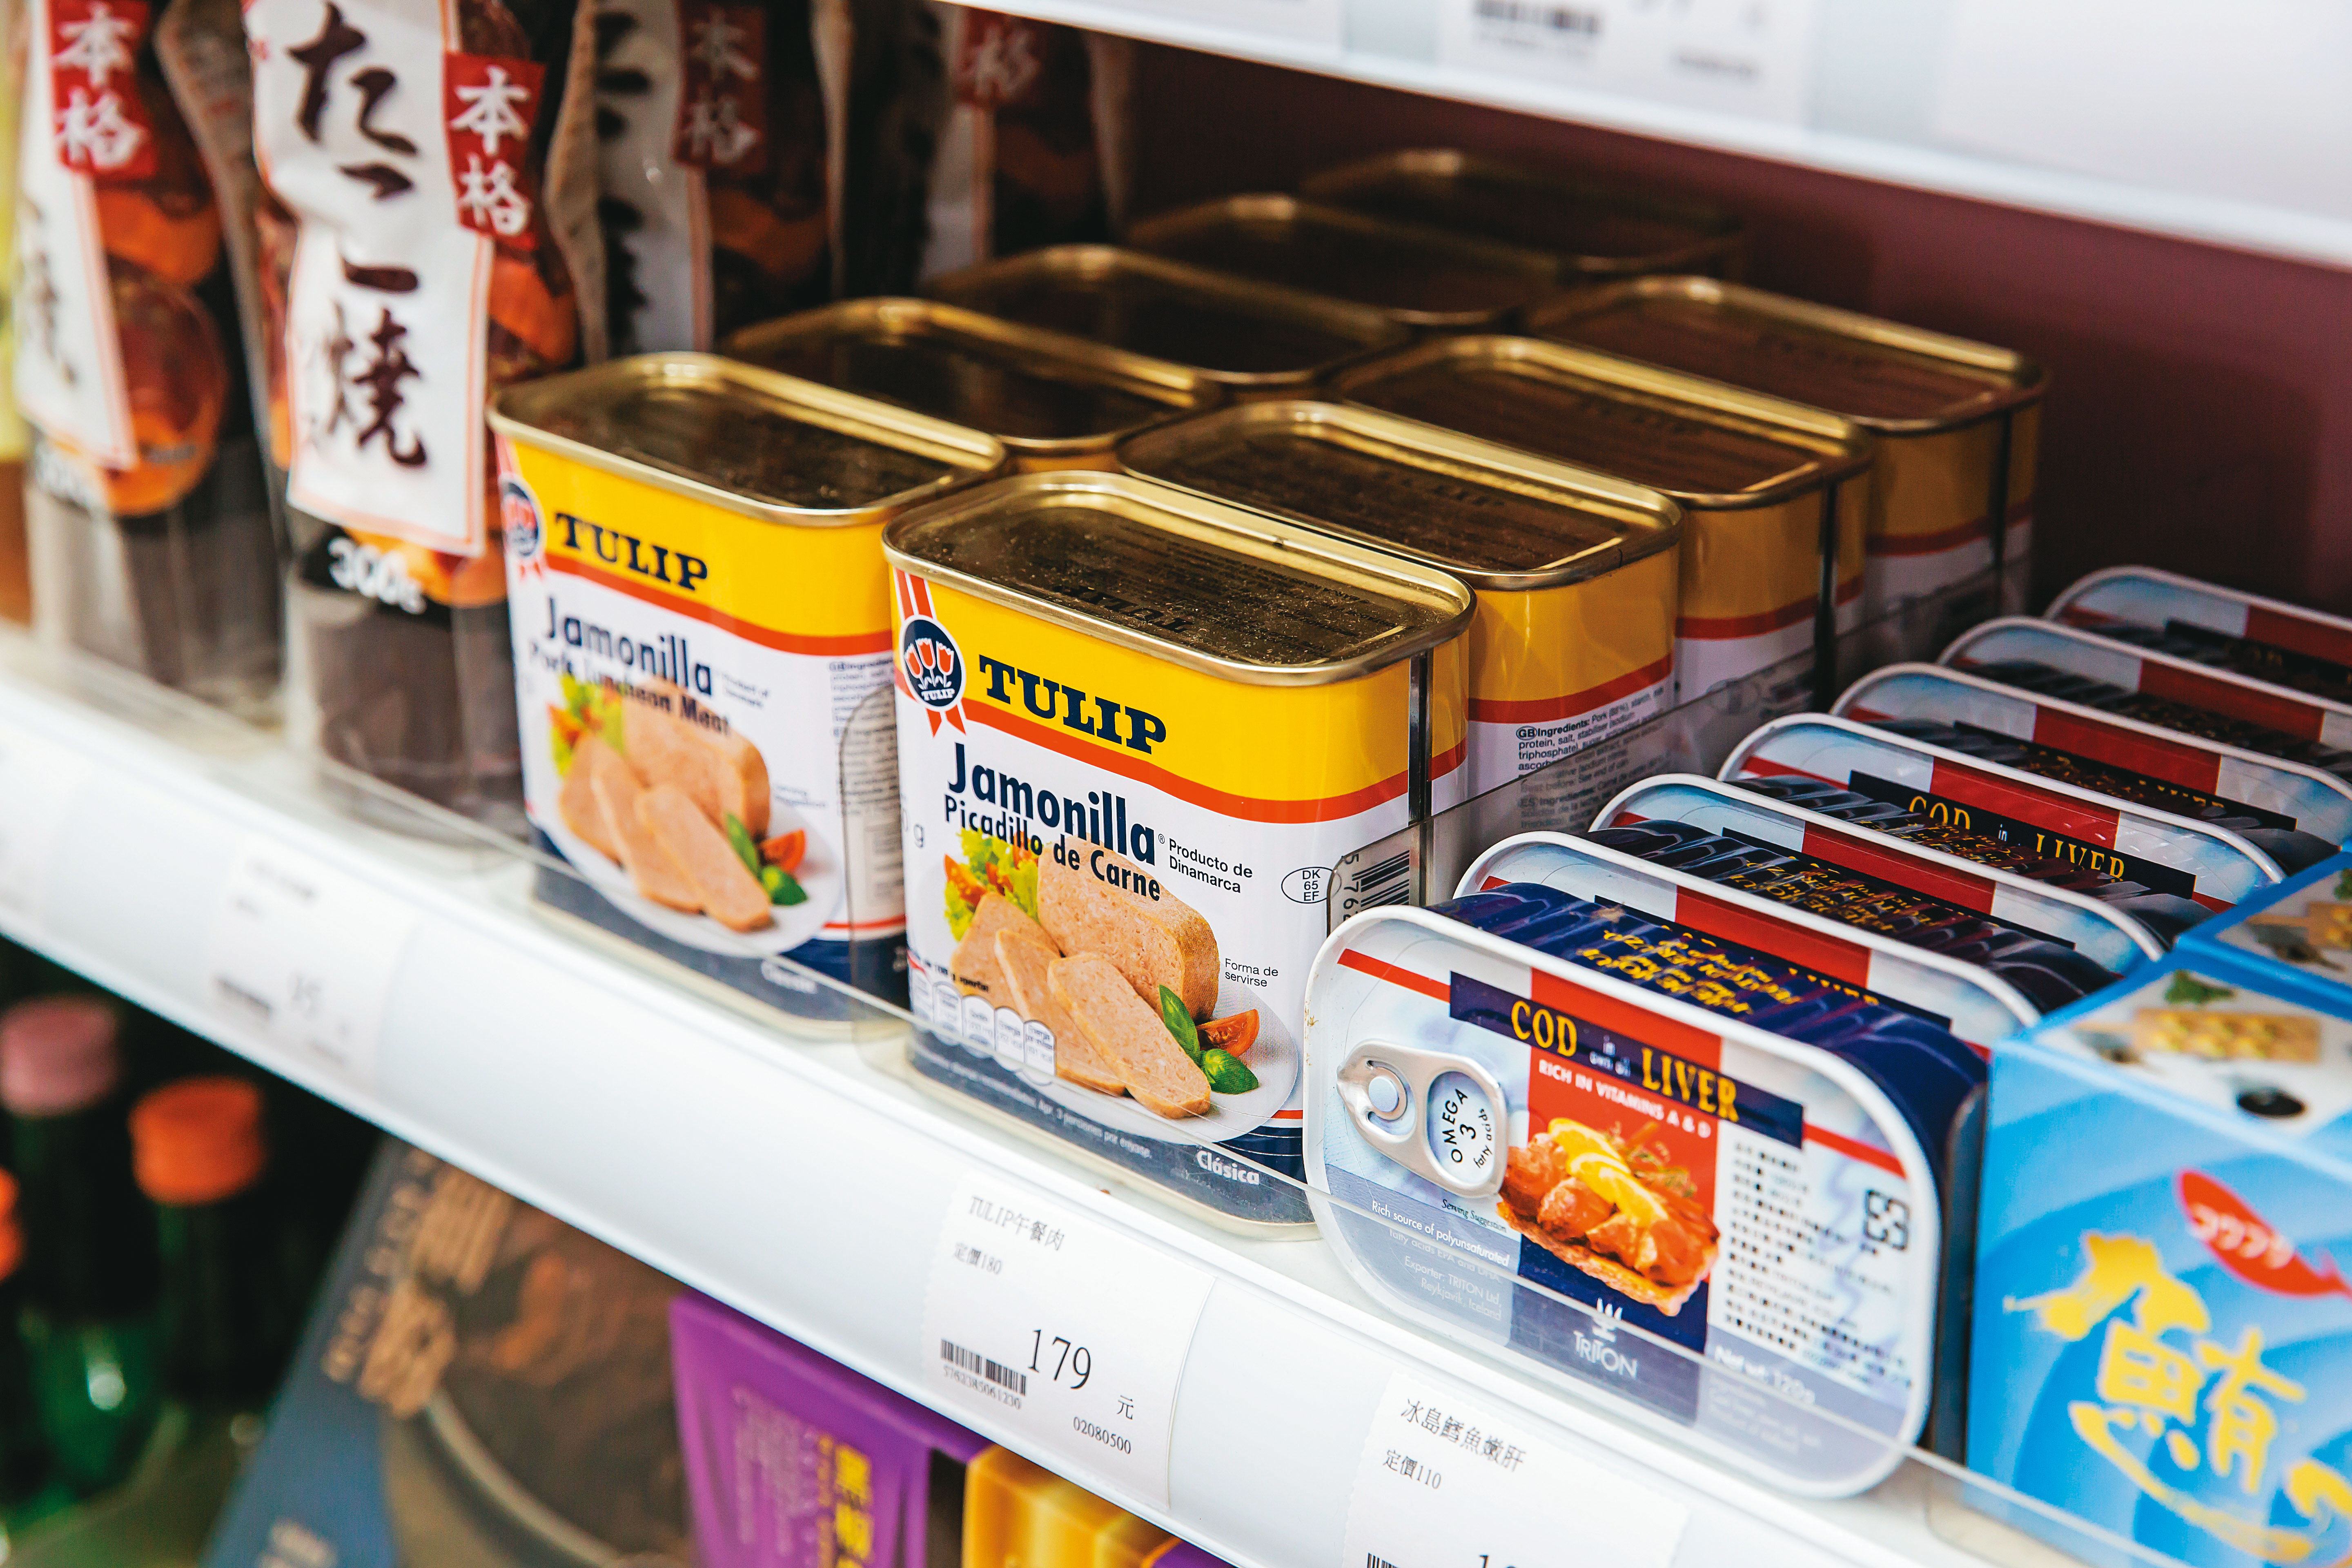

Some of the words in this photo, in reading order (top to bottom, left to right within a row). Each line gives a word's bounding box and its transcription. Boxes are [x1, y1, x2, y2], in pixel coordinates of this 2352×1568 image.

[55, 8, 145, 167] 本格
[451, 65, 532, 237] 本格
[556, 513, 708, 590] TULIP
[327, 537, 427, 616] 300g
[546, 596, 711, 696] Jamonilla
[921, 688, 955, 701] TULIP
[979, 654, 1166, 755] TULIP
[679, 695, 729, 735] Meat
[1518, 729, 1537, 738] GB
[1538, 719, 1590, 737] Ingredients:
[1519, 738, 1555, 751] protein,
[947, 742, 1155, 866] Jamonilla
[944, 794, 1043, 856] Picadillo
[1054, 833, 1080, 871] de
[1091, 851, 1161, 902] Carne
[1998, 823, 2008, 842] in
[1169, 838, 1229, 873] Producto
[1233, 863, 1254, 879] de
[1169, 855, 1241, 894] Dinamarca
[1302, 869, 1321, 880] DK
[1303, 880, 1319, 891] 65
[1303, 891, 1319, 902] EF
[1225, 958, 1260, 975] Forma
[1264, 967, 1279, 977] de
[1225, 970, 1268, 987] servirse
[1511, 1001, 1577, 1057] COD
[1539, 1060, 1572, 1084] RICH
[1575, 1073, 1592, 1092] IN
[1596, 1081, 1664, 1120] VITAMINS
[1666, 1109, 1679, 1127] A
[1682, 1115, 1695, 1132] &
[1697, 1120, 1711, 1138] D
[1642, 1047, 1739, 1122] LIVER
[1442, 1088, 1468, 1163] OMEGA
[1459, 1124, 1476, 1139] 3
[1478, 1108, 1492, 1141] acids
[1197, 1150, 1259, 1185] Clásica
[969, 1196, 1065, 1252] TULIP午餐肉
[1441, 1199, 1469, 1219] Serving
[1372, 1200, 1390, 1218] Rich
[1394, 1212, 1422, 1230] source
[1425, 1223, 1434, 1236] of
[1437, 1230, 1510, 1267] polyunsaturated
[953, 1242, 1003, 1276] 定價180
[1405, 1255, 1445, 1282] Exporter:
[1448, 1274, 1483, 1298] TRITON
[1469, 1299, 1502, 1321] Iceland
[1028, 1329, 1091, 1390] 179
[1573, 1330, 1638, 1379] TRITON
[1117, 1394, 1133, 1420] 元
[1073, 1417, 1132, 1454] 02080500
[1383, 1449, 1441, 1489] 定價110
